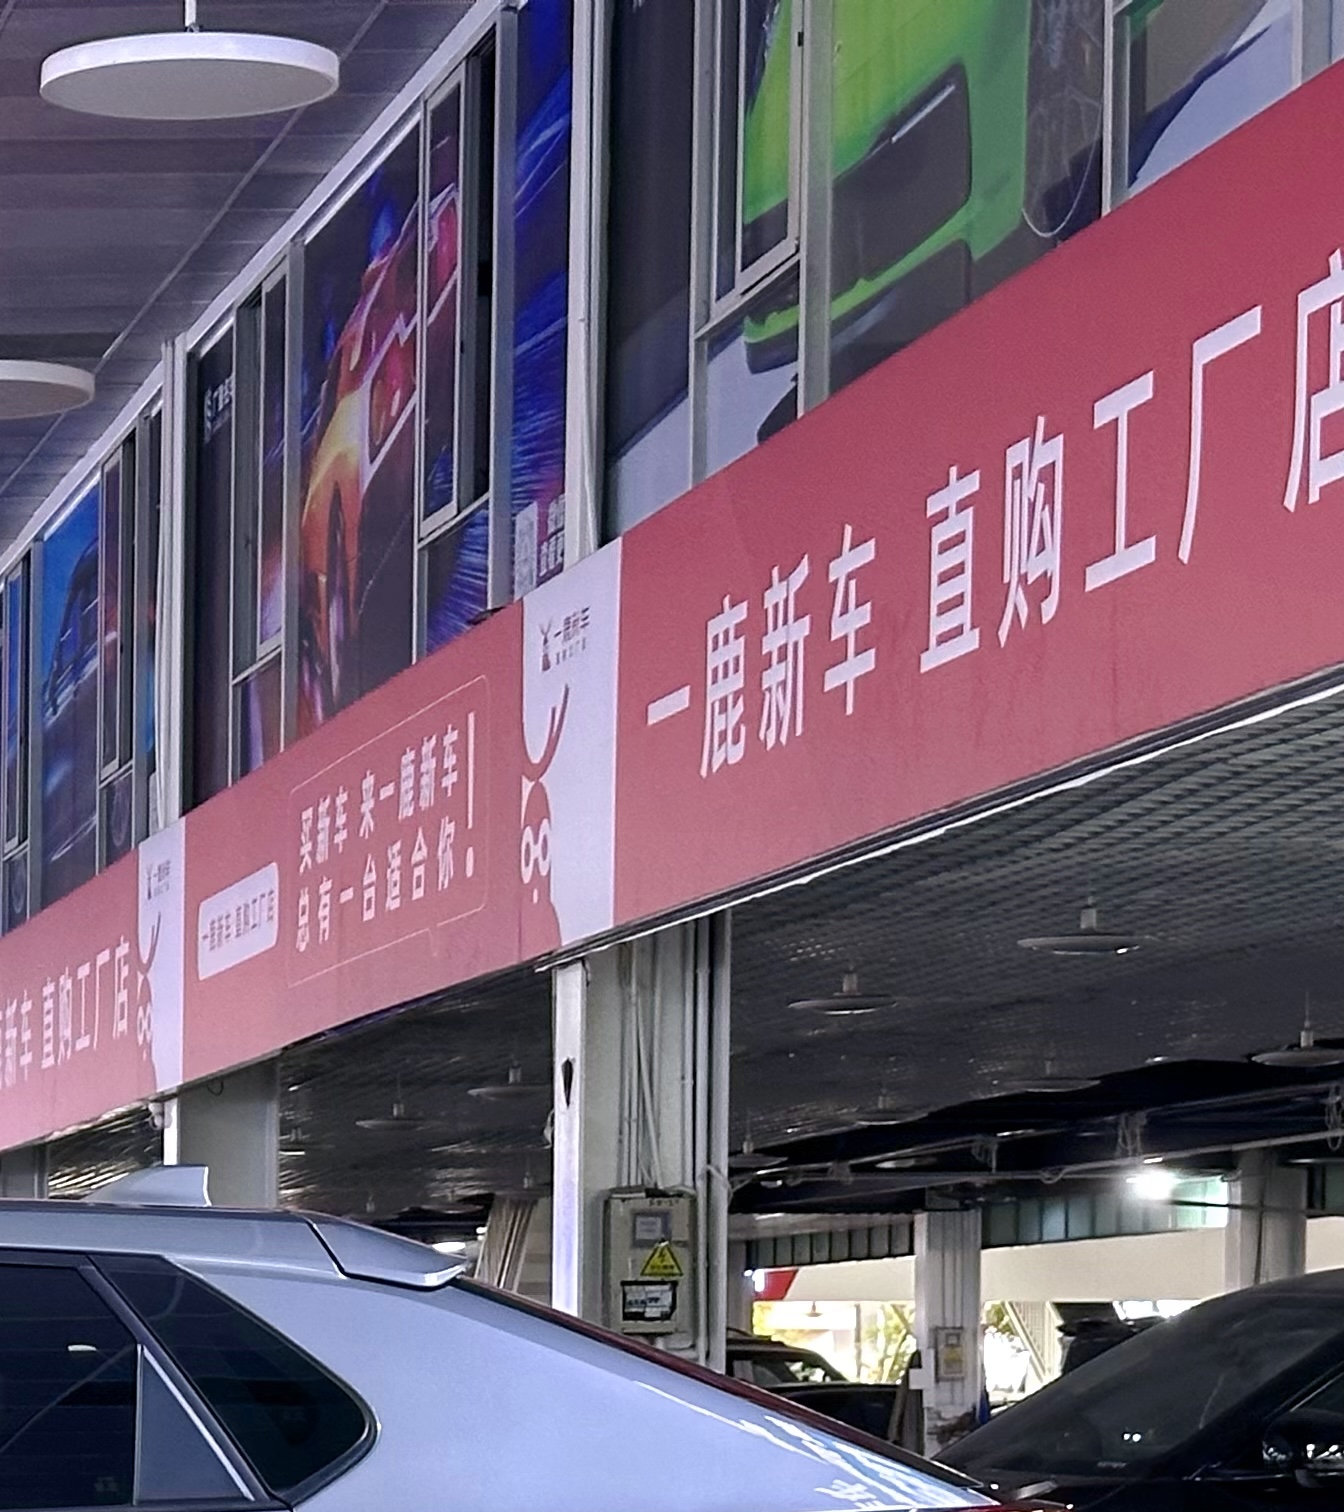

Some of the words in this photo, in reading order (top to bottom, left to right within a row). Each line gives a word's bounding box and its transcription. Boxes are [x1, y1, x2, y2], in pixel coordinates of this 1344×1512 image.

[647, 523, 876, 779] 一鹿新车
[920, 248, 1344, 674] 直购工厂店
[298, 785, 349, 876] 买新车
[359, 723, 459, 840] 来一鹿新车
[295, 815, 456, 953] 总有一台适合你
[41, 934, 130, 1069] 直购工厂店
